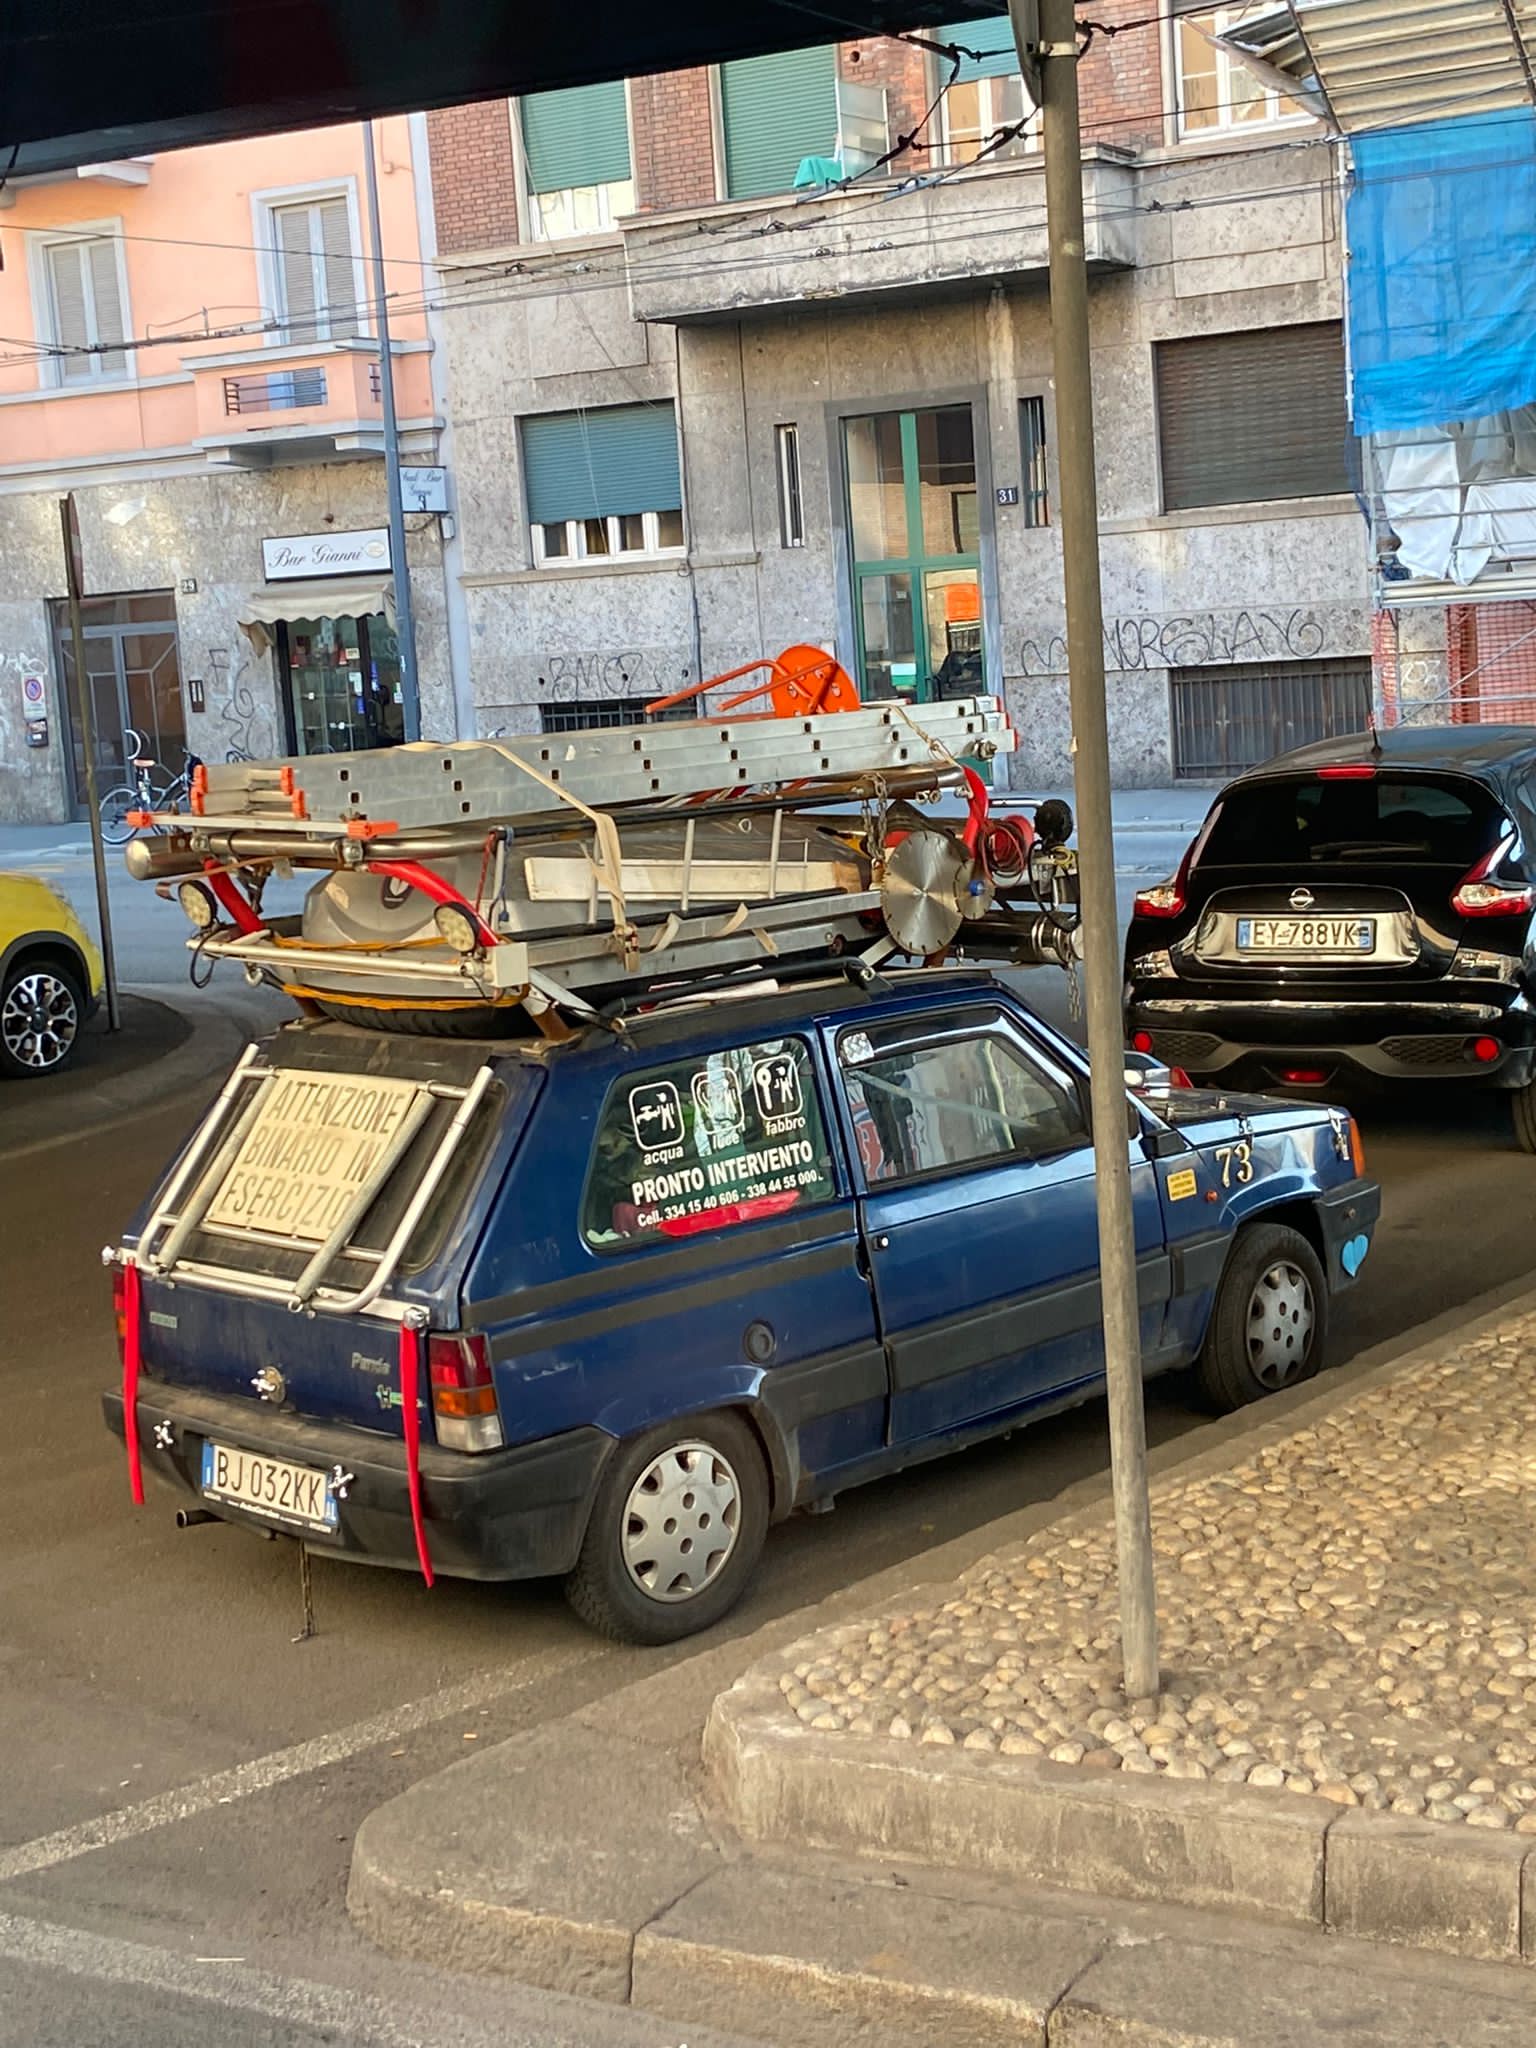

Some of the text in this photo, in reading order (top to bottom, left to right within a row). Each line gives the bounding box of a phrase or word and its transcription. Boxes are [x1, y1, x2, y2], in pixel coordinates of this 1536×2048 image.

[268, 546, 307, 568] Bar
[311, 543, 365, 565] Gianni
[266, 1079, 404, 1135] ATTENZIONE
[765, 1115, 806, 1136] fabbro
[243, 1124, 382, 1183] BINARIO IN
[643, 1145, 684, 1166] acqua
[712, 1132, 740, 1150] luce
[1215, 1143, 1253, 1188] 73
[631, 1140, 813, 1206] PRONTO INTERVENTO
[218, 1171, 357, 1229] ESERCIZIO
[637, 1209, 664, 1227] Cell.
[664, 1203, 686, 1220] 334
[687, 1199, 702, 1214] 15
[703, 1195, 717, 1209] 40
[746, 1182, 767, 1199] 338
[768, 1177, 782, 1193] 44
[783, 1174, 797, 1189] 55
